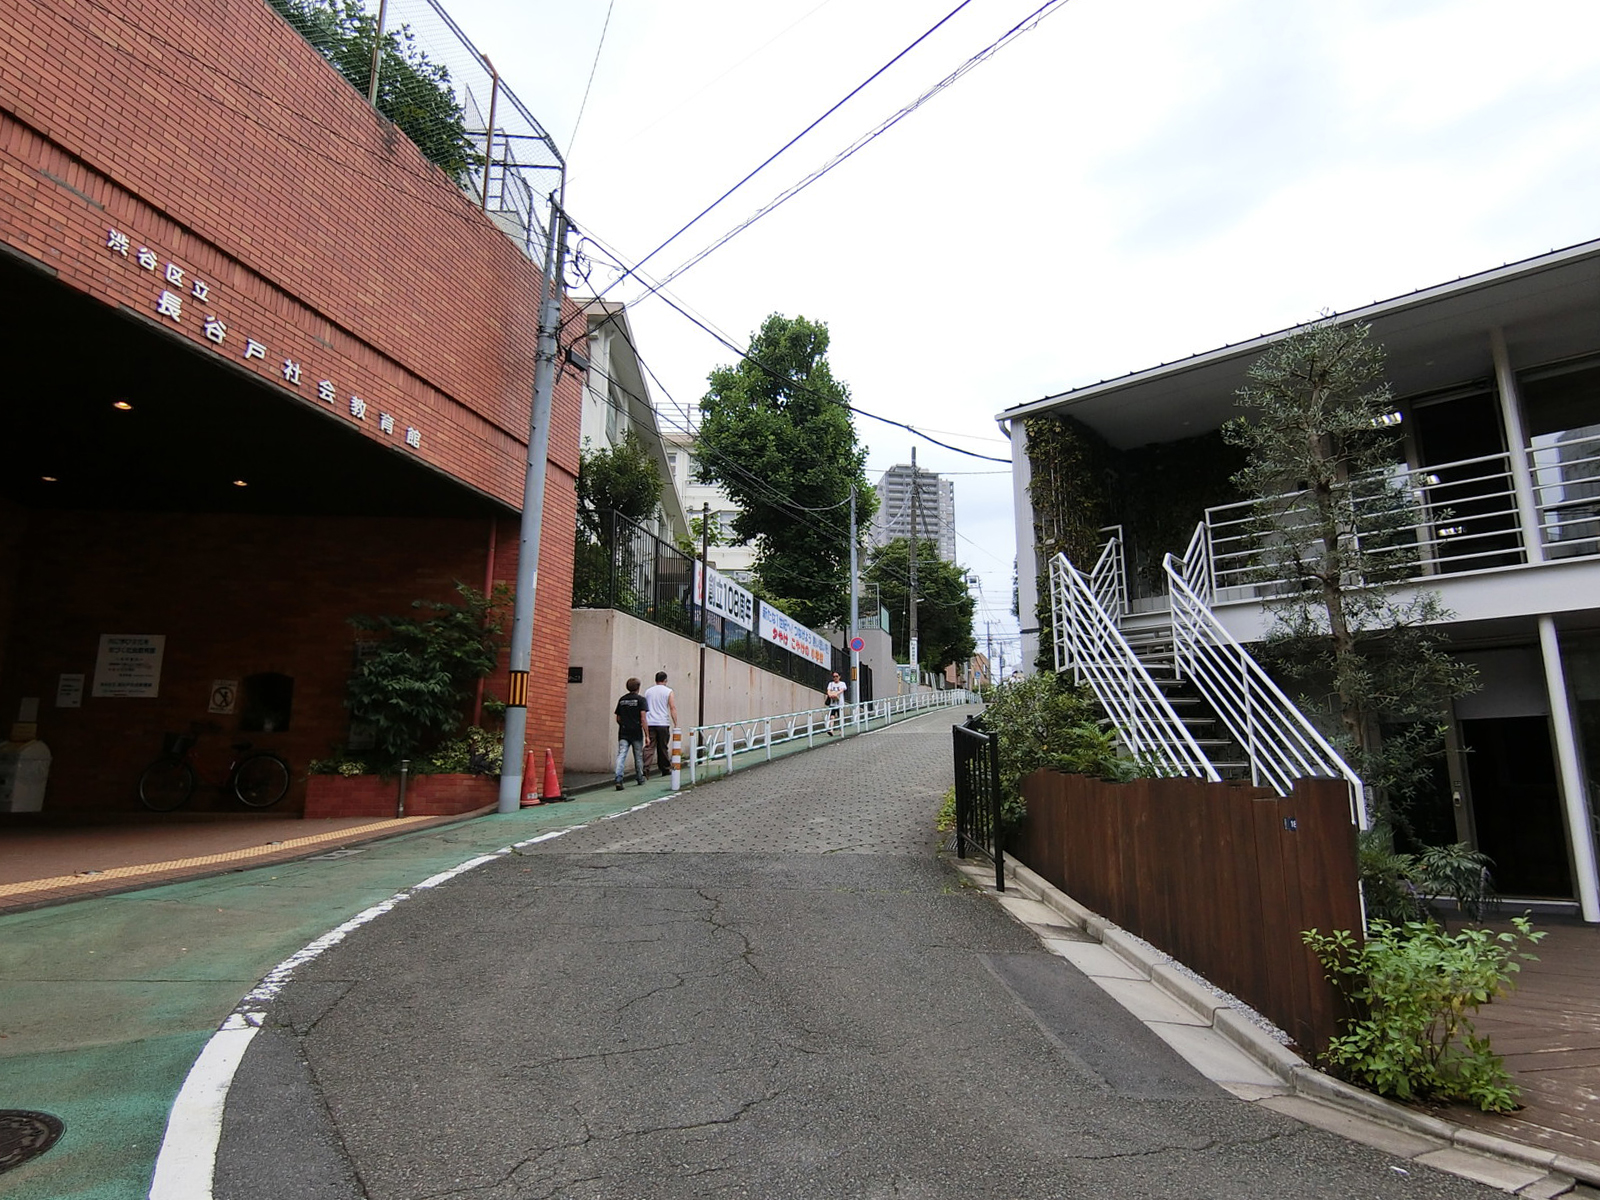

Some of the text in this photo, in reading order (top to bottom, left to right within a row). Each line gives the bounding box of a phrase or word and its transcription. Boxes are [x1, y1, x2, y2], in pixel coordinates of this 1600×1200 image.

[106, 228, 211, 303] 渋谷区立
[157, 290, 422, 450] 長谷戸社会教育館
